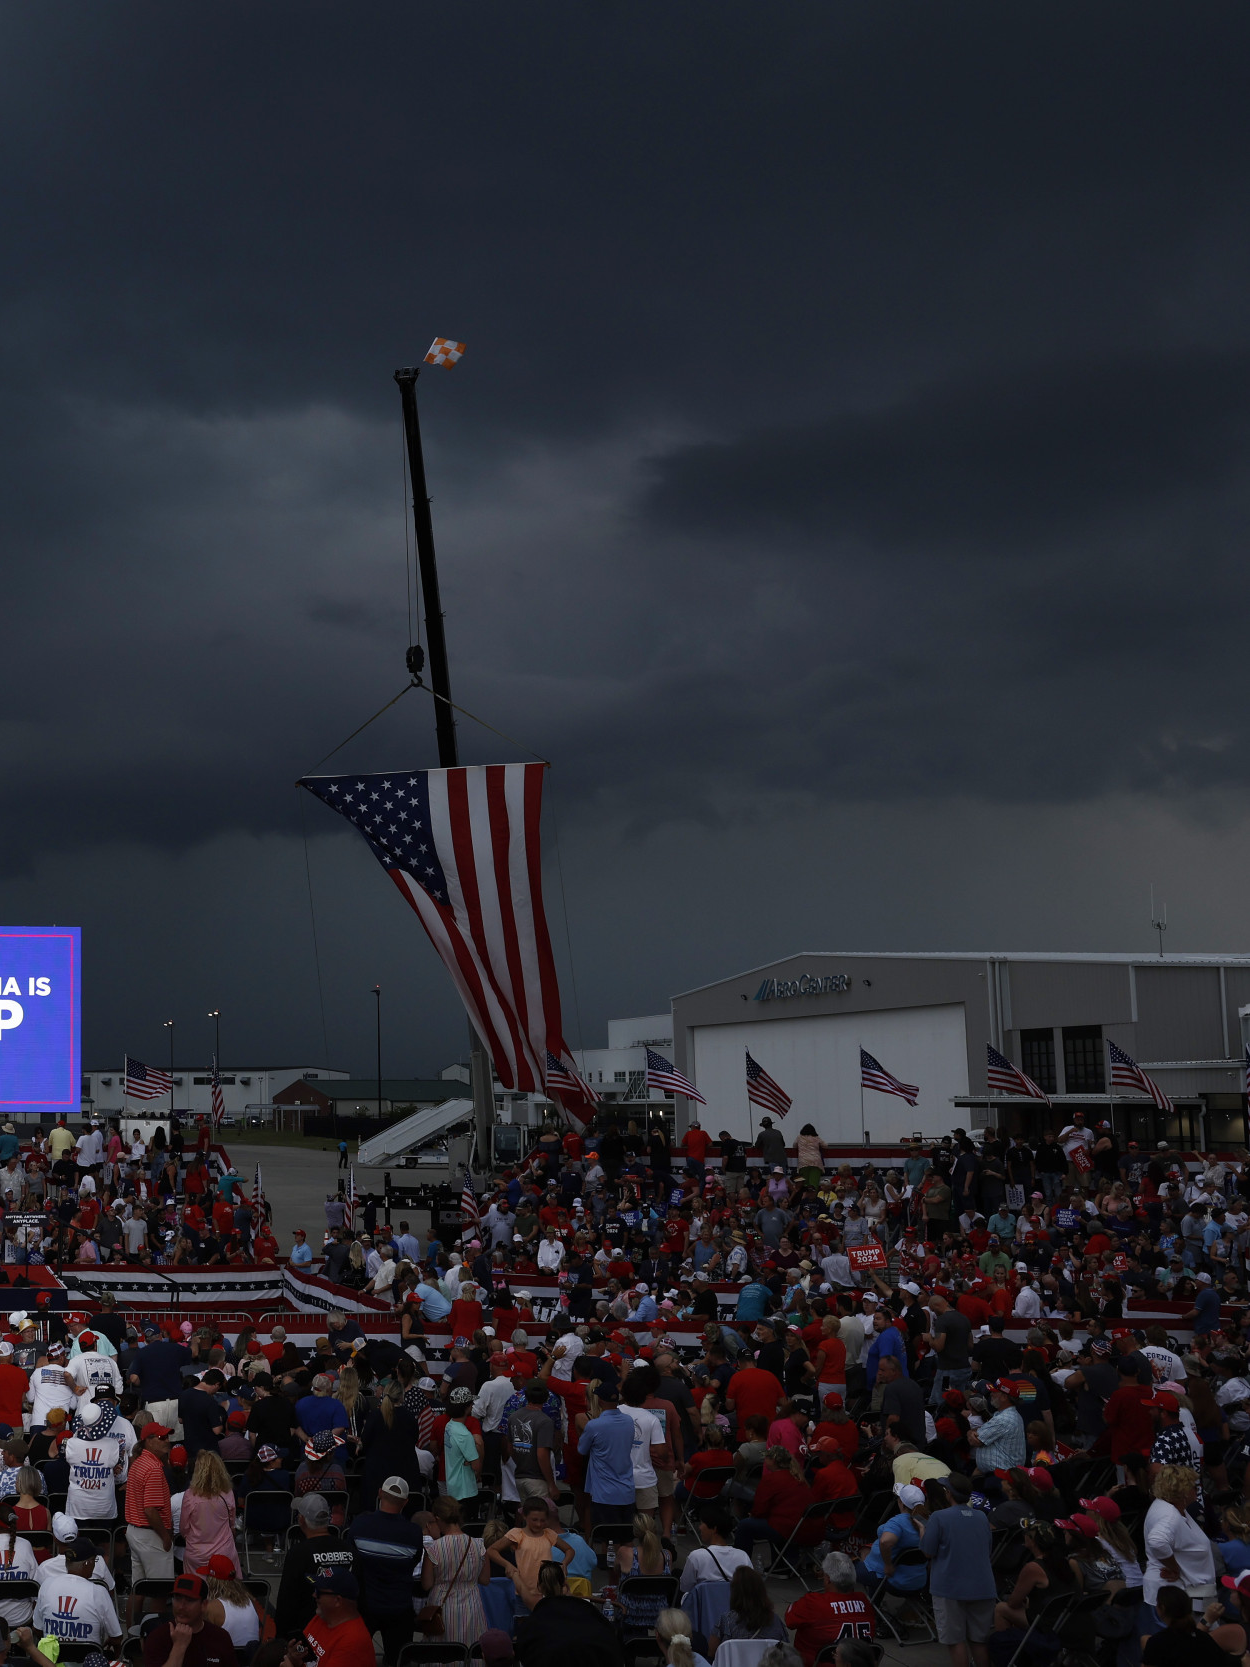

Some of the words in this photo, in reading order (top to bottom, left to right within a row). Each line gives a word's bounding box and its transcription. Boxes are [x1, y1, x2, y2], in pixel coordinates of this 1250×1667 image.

[28, 976, 51, 996] IS
[851, 1248, 880, 1258] TRUMP
[857, 1255, 878, 1263] 2024
[1146, 1353, 1172, 1362] EGEND
[74, 1465, 111, 1479] TRUMP
[80, 1479, 101, 1490] 2024
[830, 1600, 865, 1614] TRUMP
[44, 1618, 92, 1638] TRUMP
